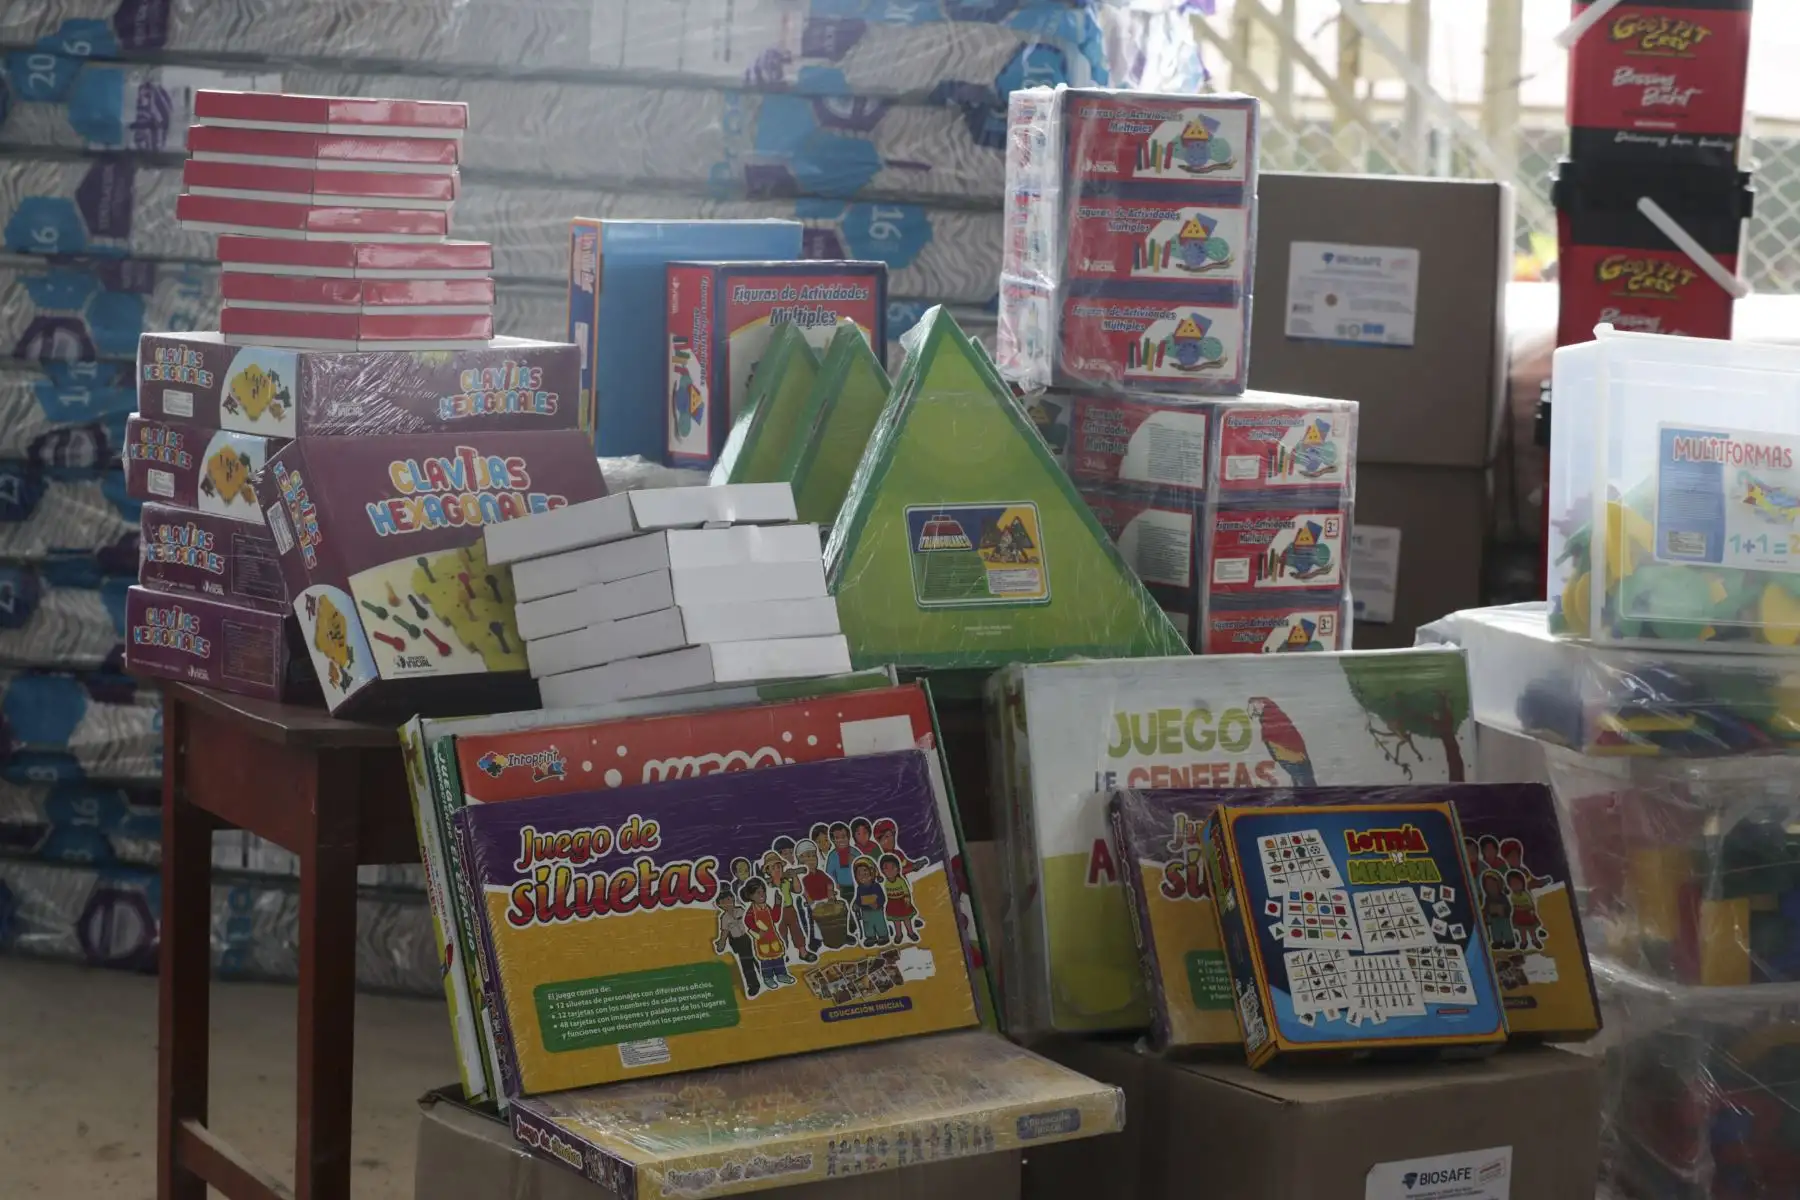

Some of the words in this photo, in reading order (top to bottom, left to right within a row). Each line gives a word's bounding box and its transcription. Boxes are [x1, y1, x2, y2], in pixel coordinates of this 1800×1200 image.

[27, 53, 57, 89] 20
[869, 204, 906, 241] 16
[733, 284, 779, 304] Figuras
[779, 283, 797, 301] de
[798, 283, 870, 301] Actividades
[769, 304, 837, 329] Múltiples
[155, 344, 203, 368] CLAVIJAS
[144, 364, 214, 388] HEXAGONALES
[460, 359, 543, 391] CLAVIJAS
[439, 391, 558, 420] HEXAGONALES
[1673, 434, 1793, 468] MULTIFORMAS
[389, 445, 531, 494] CLAVIJAS
[158, 522, 215, 551] CLAVIJAS
[147, 543, 226, 575] HEXAGONALES
[146, 605, 201, 635] CLAVIJAS
[133, 626, 211, 659] HEXAGONALES
[1108, 708, 1253, 758] JUEGO
[438, 752, 454, 814] JUEGO
[514, 825, 614, 872] Juego
[616, 814, 661, 854] de
[505, 856, 719, 929] siluetas
[455, 870, 475, 951] ESPACIO
[548, 992, 555, 1000] El
[555, 990, 576, 1001] juego
[576, 987, 599, 997] consta
[600, 986, 611, 994] de:
[558, 1011, 567, 1019] 12
[567, 1008, 594, 1018] tarjetas
[608, 1003, 619, 1012] los
[619, 1000, 650, 1010] nombres
[660, 996, 678, 1005] cada
[678, 990, 714, 1003] personaje.
[565, 999, 592, 1008] siluetas
[593, 996, 602, 1004] de
[603, 991, 640, 1004] personajes
[641, 990, 653, 998] con
[654, 984, 688, 995] diferentes
[569, 1017, 597, 1028] tarjetas
[597, 1015, 610, 1023] con
[610, 1009, 644, 1021] imágenes
[645, 1010, 650, 1018] y
[650, 1005, 679, 1017] palabras
[680, 1003, 690, 1011] de
[690, 1001, 701, 1009] los
[701, 998, 726, 1009] lugares
[828, 1003, 875, 1018] EDUCACIÓN
[876, 1000, 905, 1014] INICIAL
[561, 1032, 567, 1040] y
[567, 1027, 601, 1037] funciones
[602, 1025, 616, 1035] que
[661, 1014, 672, 1023] los
[1419, 1166, 1473, 1187] BIOSAFE
